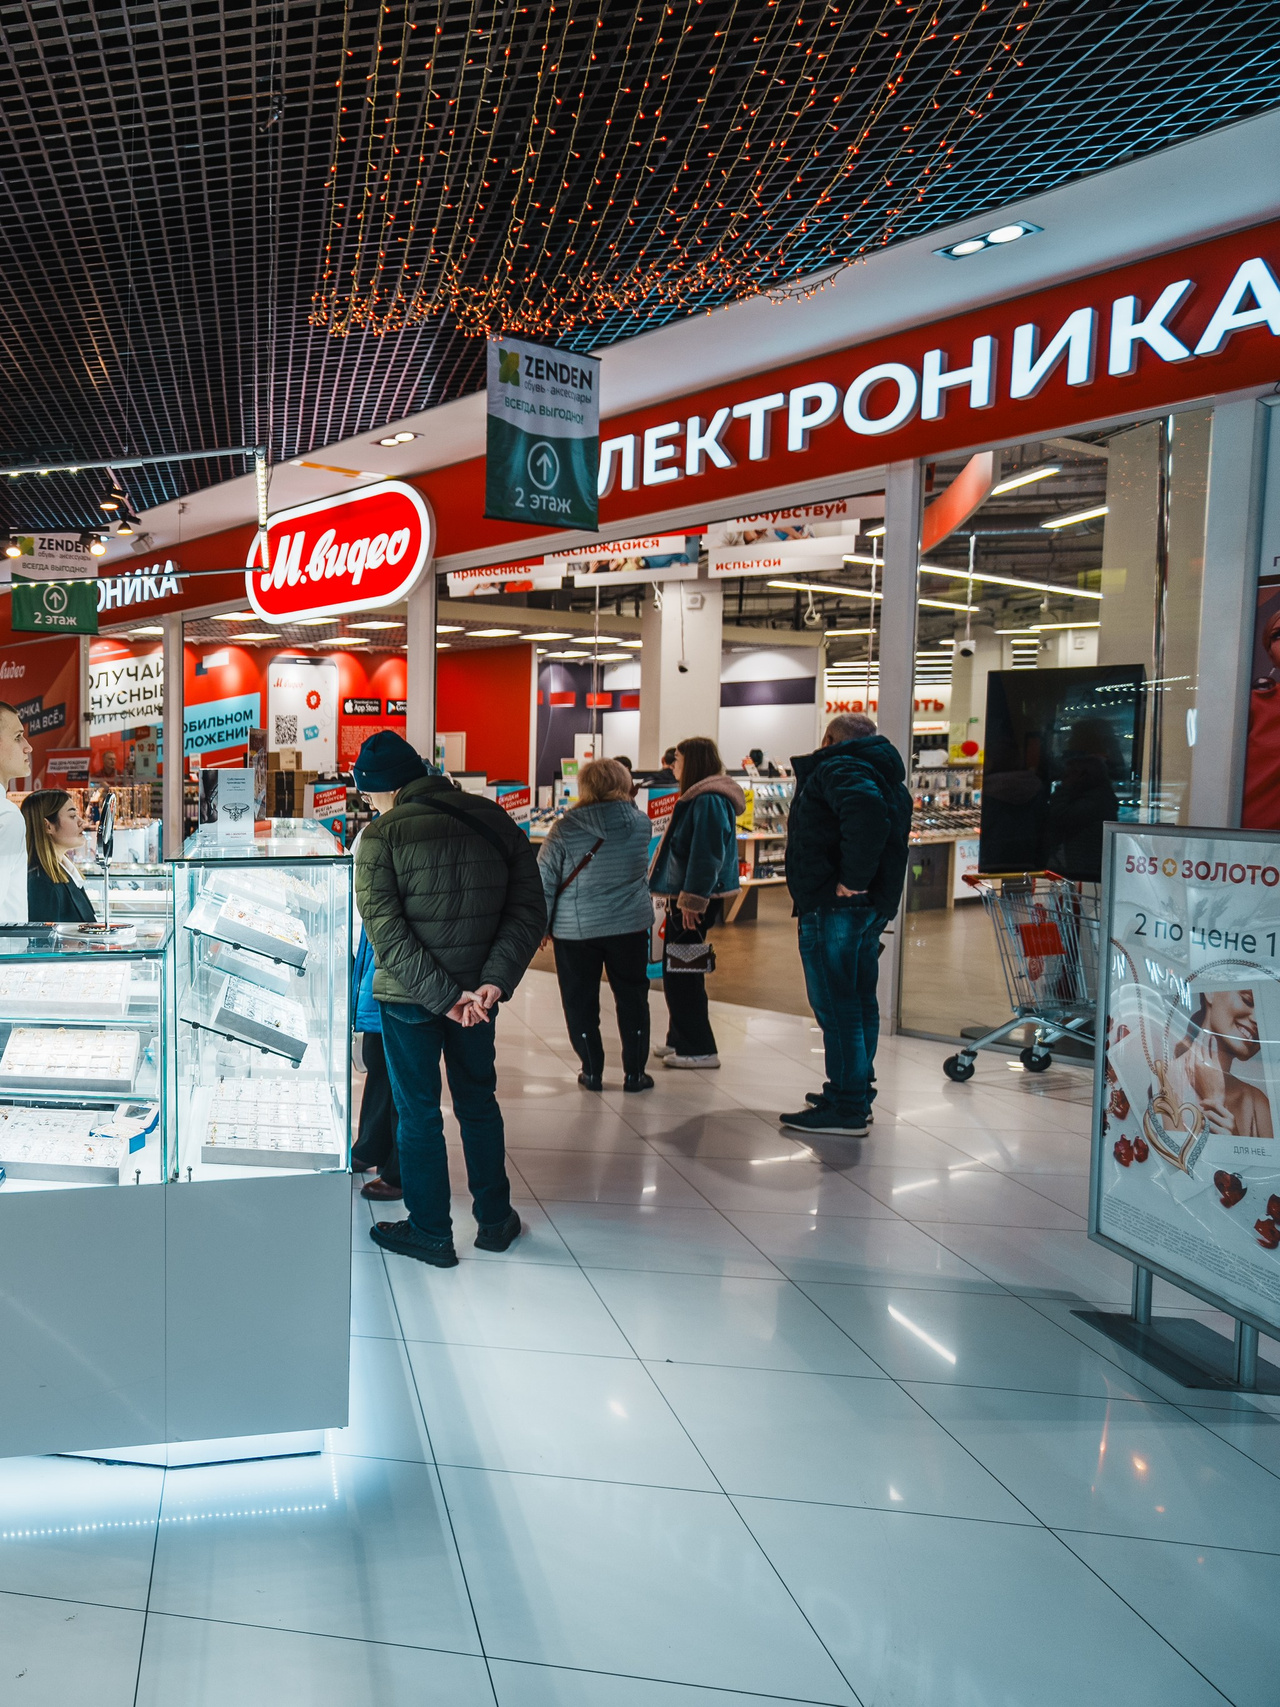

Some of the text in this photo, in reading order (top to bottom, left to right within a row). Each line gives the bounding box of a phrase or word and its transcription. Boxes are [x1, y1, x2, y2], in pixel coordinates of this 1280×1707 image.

[524, 355, 593, 391] ZENDEN
[524, 380, 592, 405] обувь аксессуары
[504, 396, 584, 425] ВСЕГДА ВЫГОДНО!
[514, 487, 572, 514] 2 этаж
[22, 562, 88, 574] ВСЕГДА ВЫГОДНО!
[260, 527, 411, 592] М.видео
[34, 612, 77, 626] 2 этаж
[29, 719, 41, 732] НА
[650, 795, 675, 809] СКИДКИ
[1125, 855, 1158, 875] 585
[1135, 913, 1276, 957] 2 по цене 1
